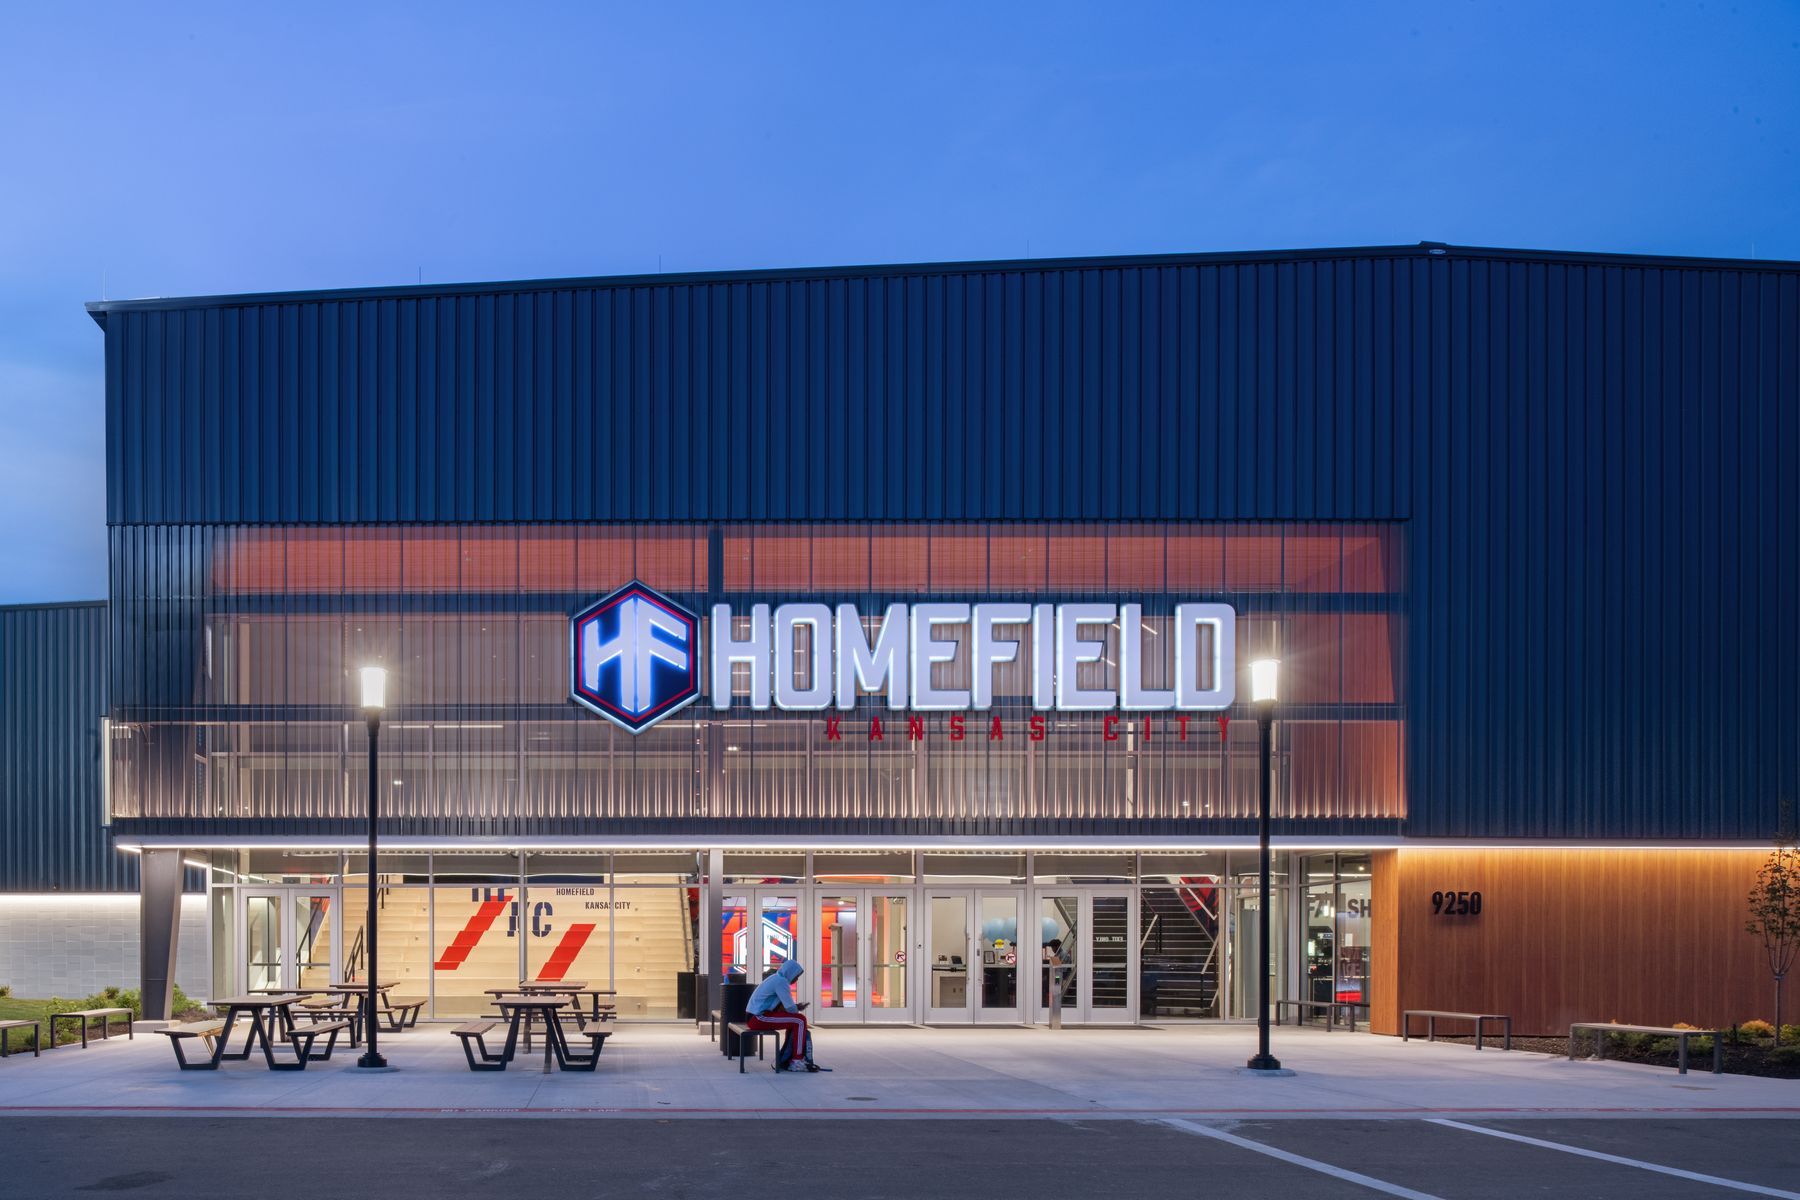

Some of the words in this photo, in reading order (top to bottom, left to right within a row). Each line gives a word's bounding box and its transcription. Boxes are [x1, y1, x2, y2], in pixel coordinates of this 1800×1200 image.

[584, 597, 687, 713] HF
[711, 602, 1236, 711] HOMEFIELD
[826, 715, 1046, 742] KANSAS
[1103, 715, 1231, 742] CITY
[614, 902, 631, 910] CITY
[1431, 890, 1482, 916] 9250
